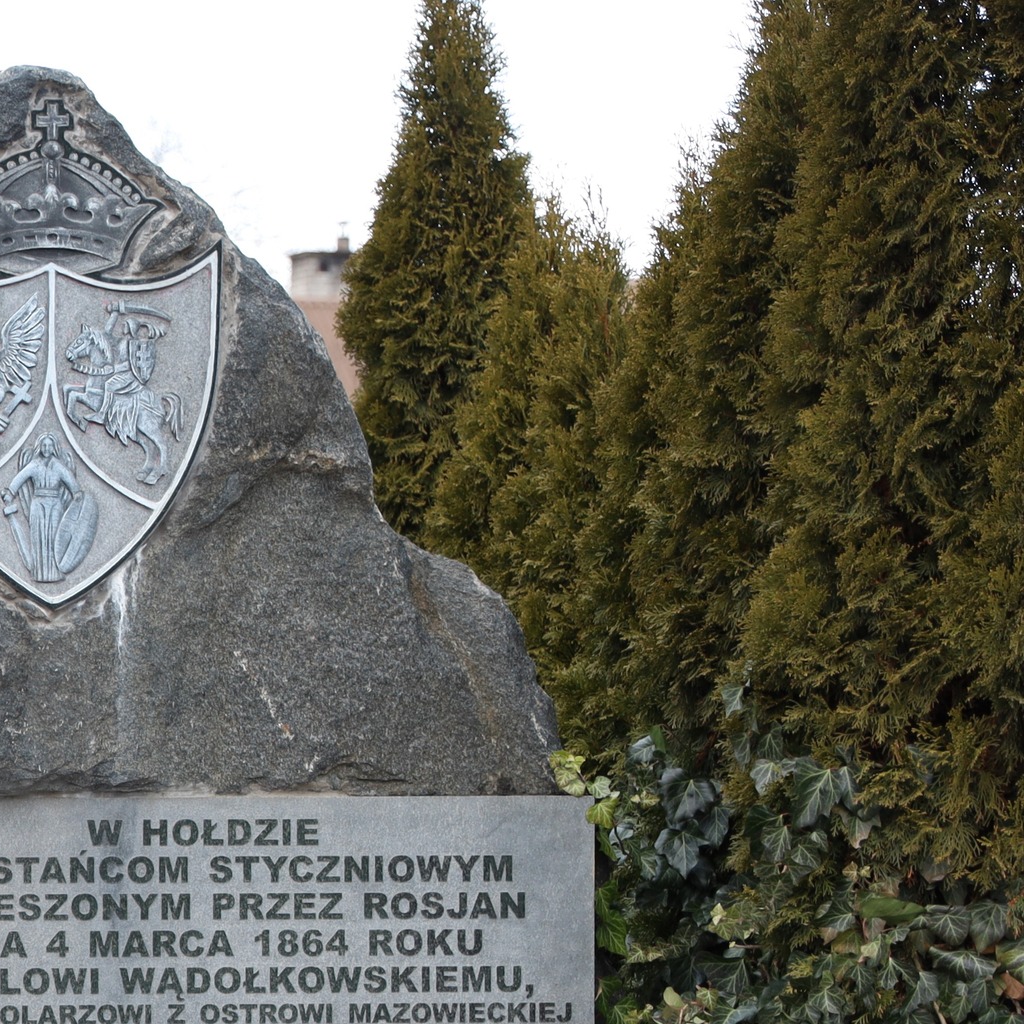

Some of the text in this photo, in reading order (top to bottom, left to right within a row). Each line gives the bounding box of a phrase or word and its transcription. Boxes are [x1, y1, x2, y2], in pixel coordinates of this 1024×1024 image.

[87, 818, 319, 847] W HOŁDZIE
[209, 854, 514, 884] STYCZNIOWYM
[212, 892, 344, 920] PRZEZ
[363, 891, 526, 920] ROSJAN
[46, 930, 70, 958] 4
[89, 929, 234, 958] MARCA
[254, 929, 349, 957] 1864
[368, 928, 483, 957] ROKU
[119, 965, 535, 1002] WĄDOŁKOWSKIEMU,
[167, 1004, 186, 1024] Z
[200, 1003, 333, 1024] OSTROWI
[348, 1001, 573, 1024] MAZOWIECKIEJ
